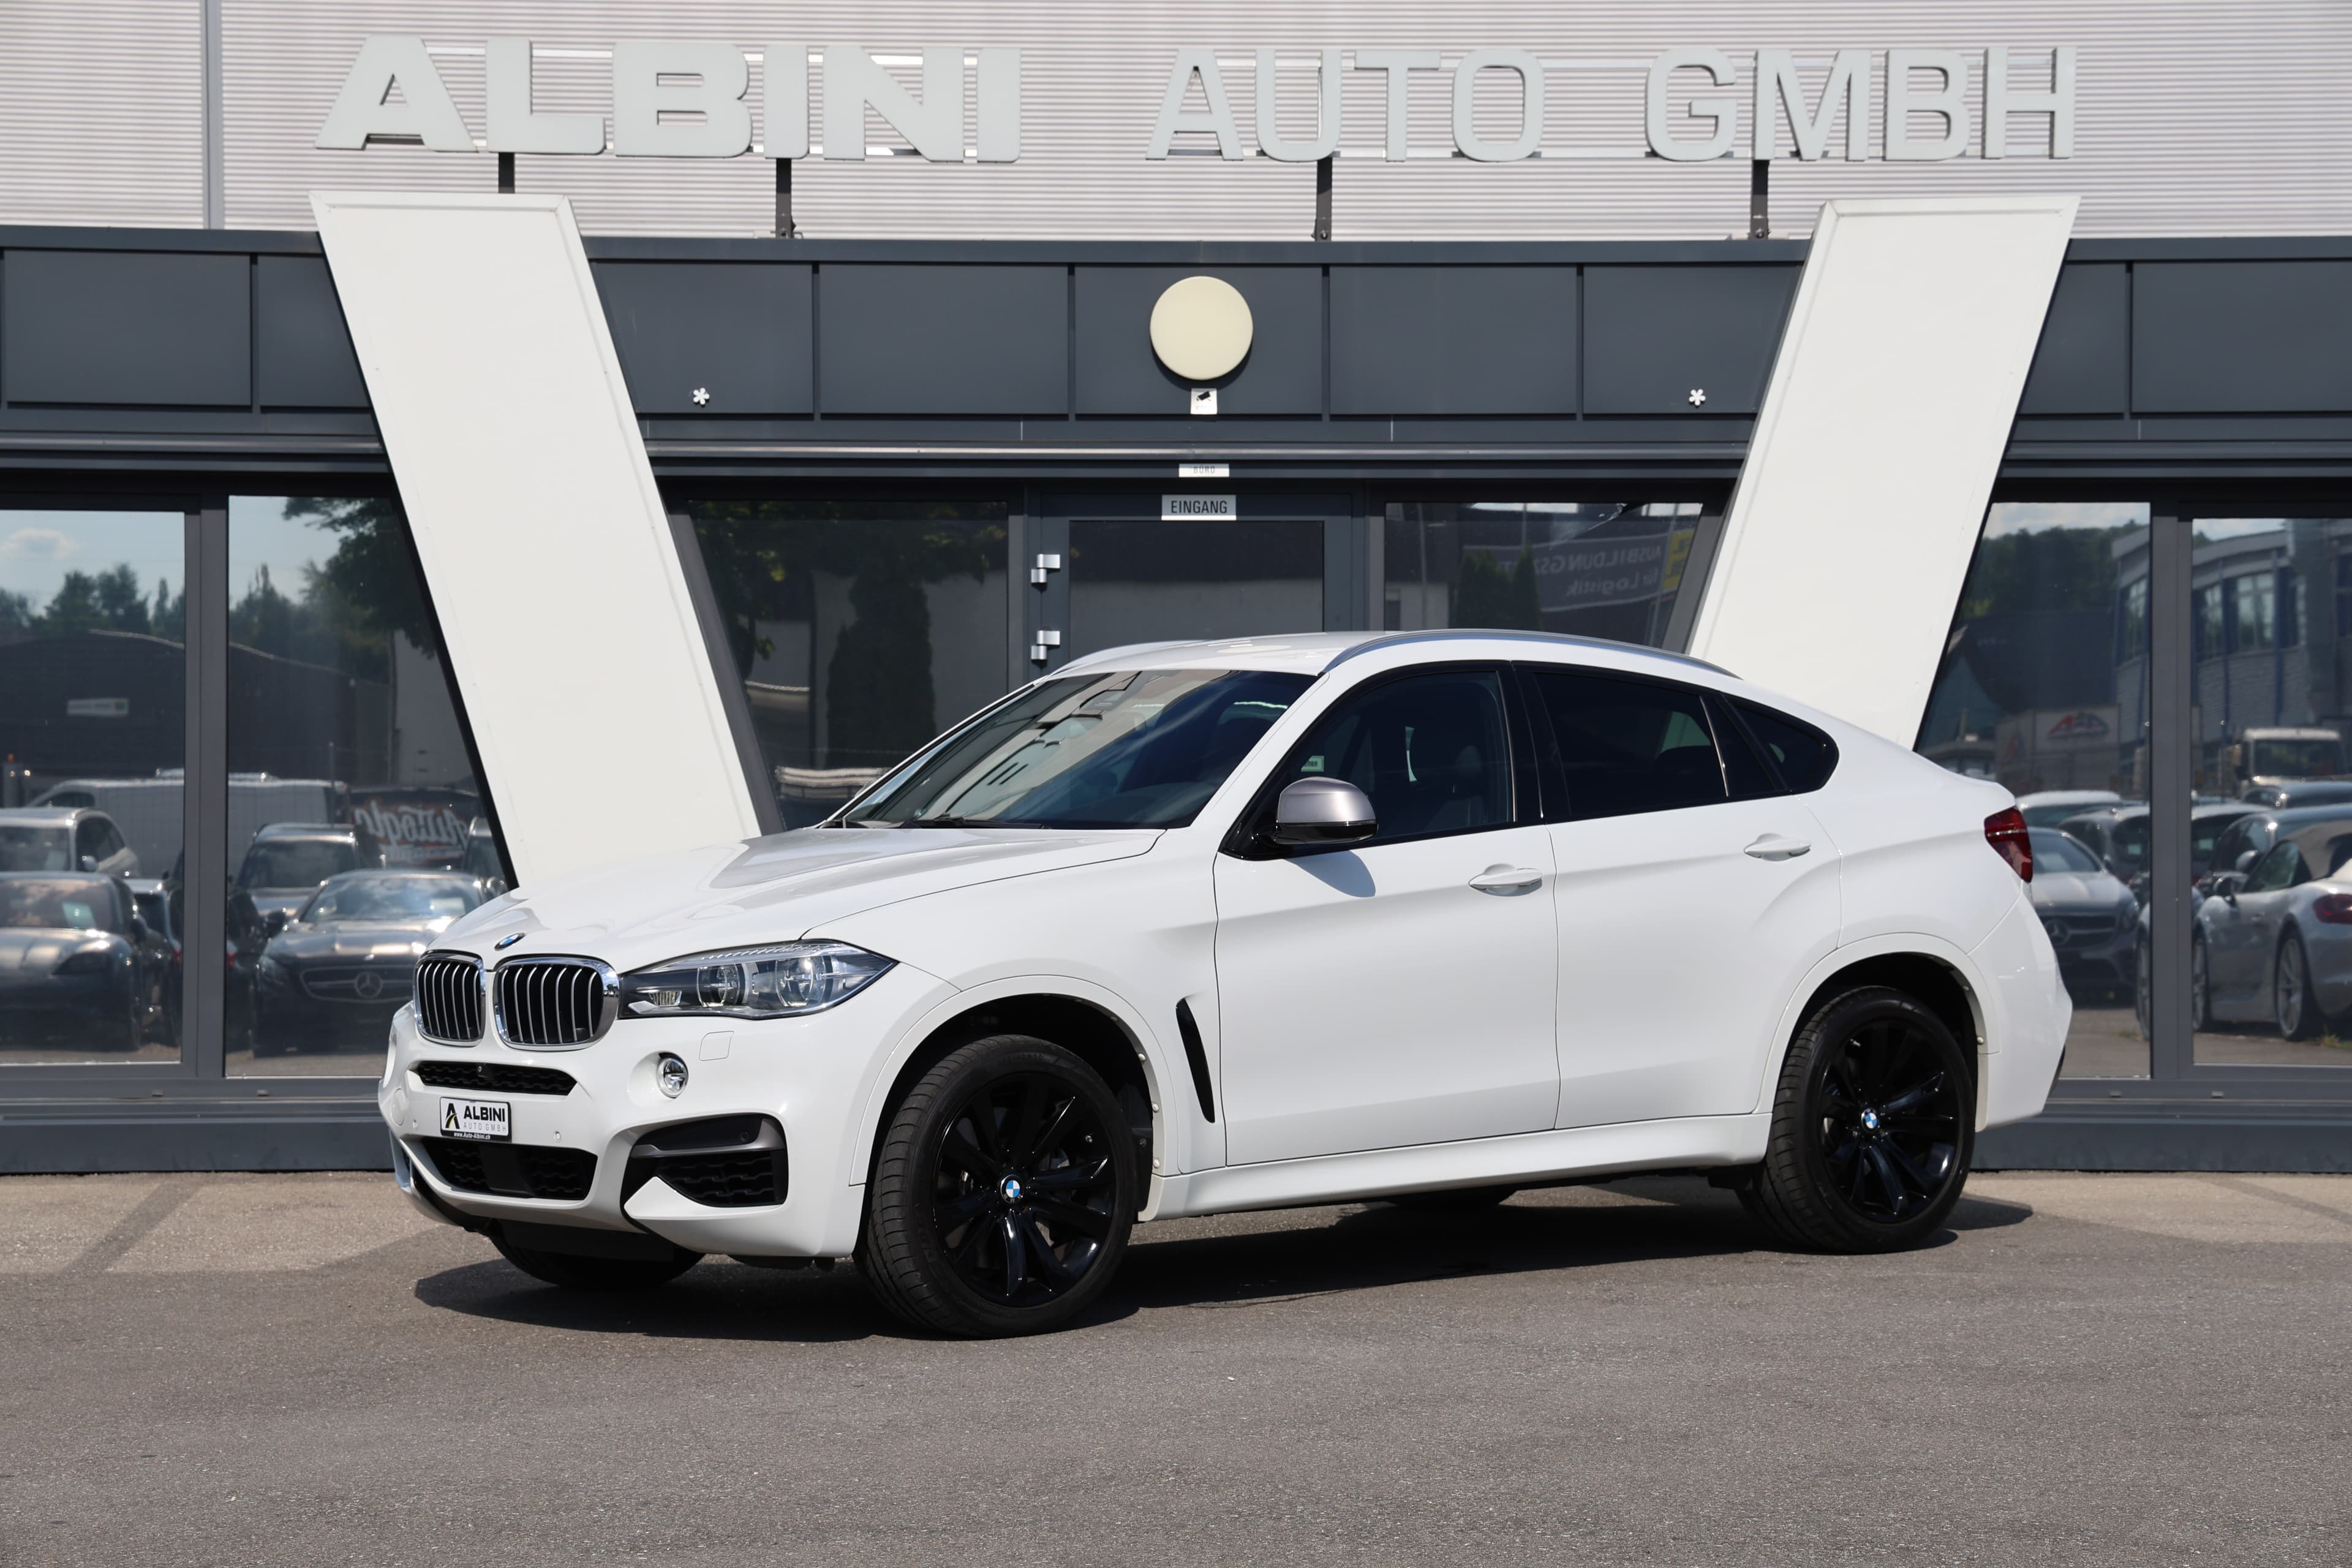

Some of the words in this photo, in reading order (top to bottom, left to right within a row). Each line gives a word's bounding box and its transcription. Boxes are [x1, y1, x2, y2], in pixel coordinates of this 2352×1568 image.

[315, 34, 1022, 163] ALBINI
[1145, 48, 1545, 162] AUTO
[1645, 46, 2078, 162] GMBH
[1194, 465, 1215, 474] BÜRO
[1171, 500, 1227, 514] EINGANG
[464, 1105, 505, 1122] ALBINI
[464, 1121, 483, 1131] AUTO
[486, 1123, 506, 1133] GMBH
